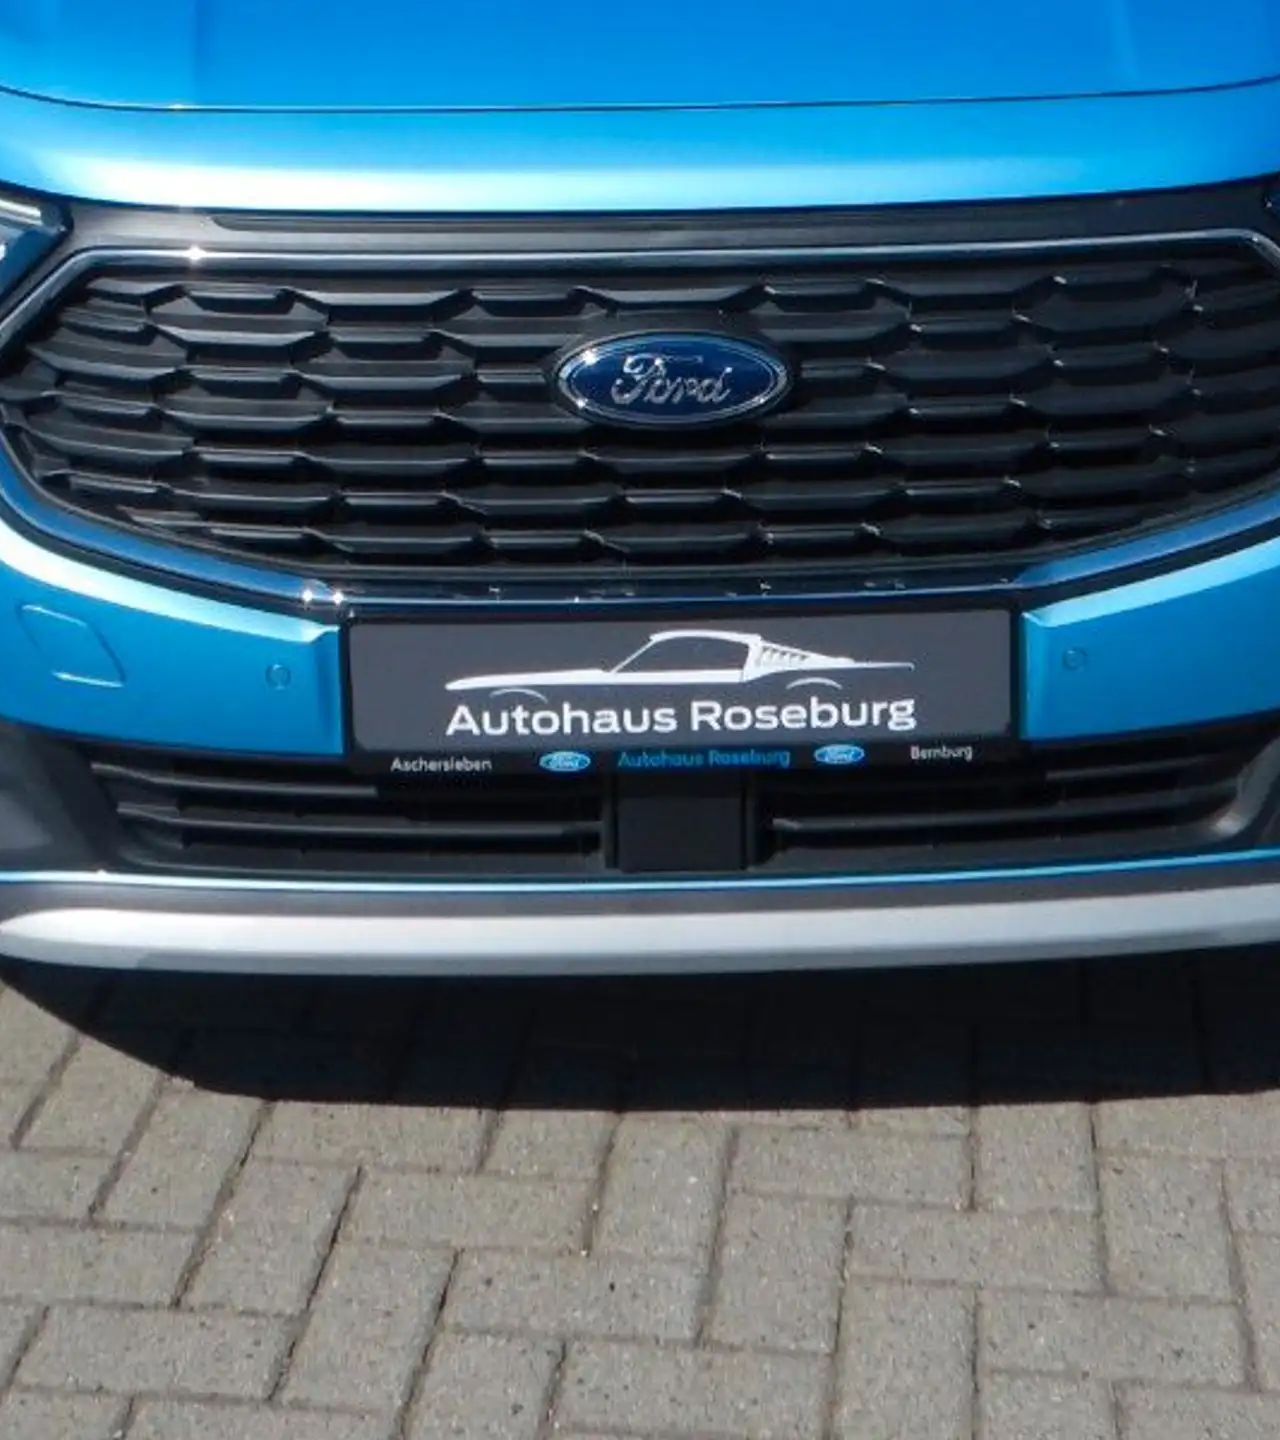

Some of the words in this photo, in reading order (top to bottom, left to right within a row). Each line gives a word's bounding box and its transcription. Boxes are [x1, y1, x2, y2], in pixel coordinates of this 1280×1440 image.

[611, 353, 733, 404] Ford
[445, 697, 678, 737] Autohaus
[690, 695, 917, 732] Roseburg
[390, 757, 493, 773] Aschersleben
[618, 752, 702, 769] Autohaus
[708, 748, 791, 767] Roseburg
[910, 745, 973, 761] Bernburg
